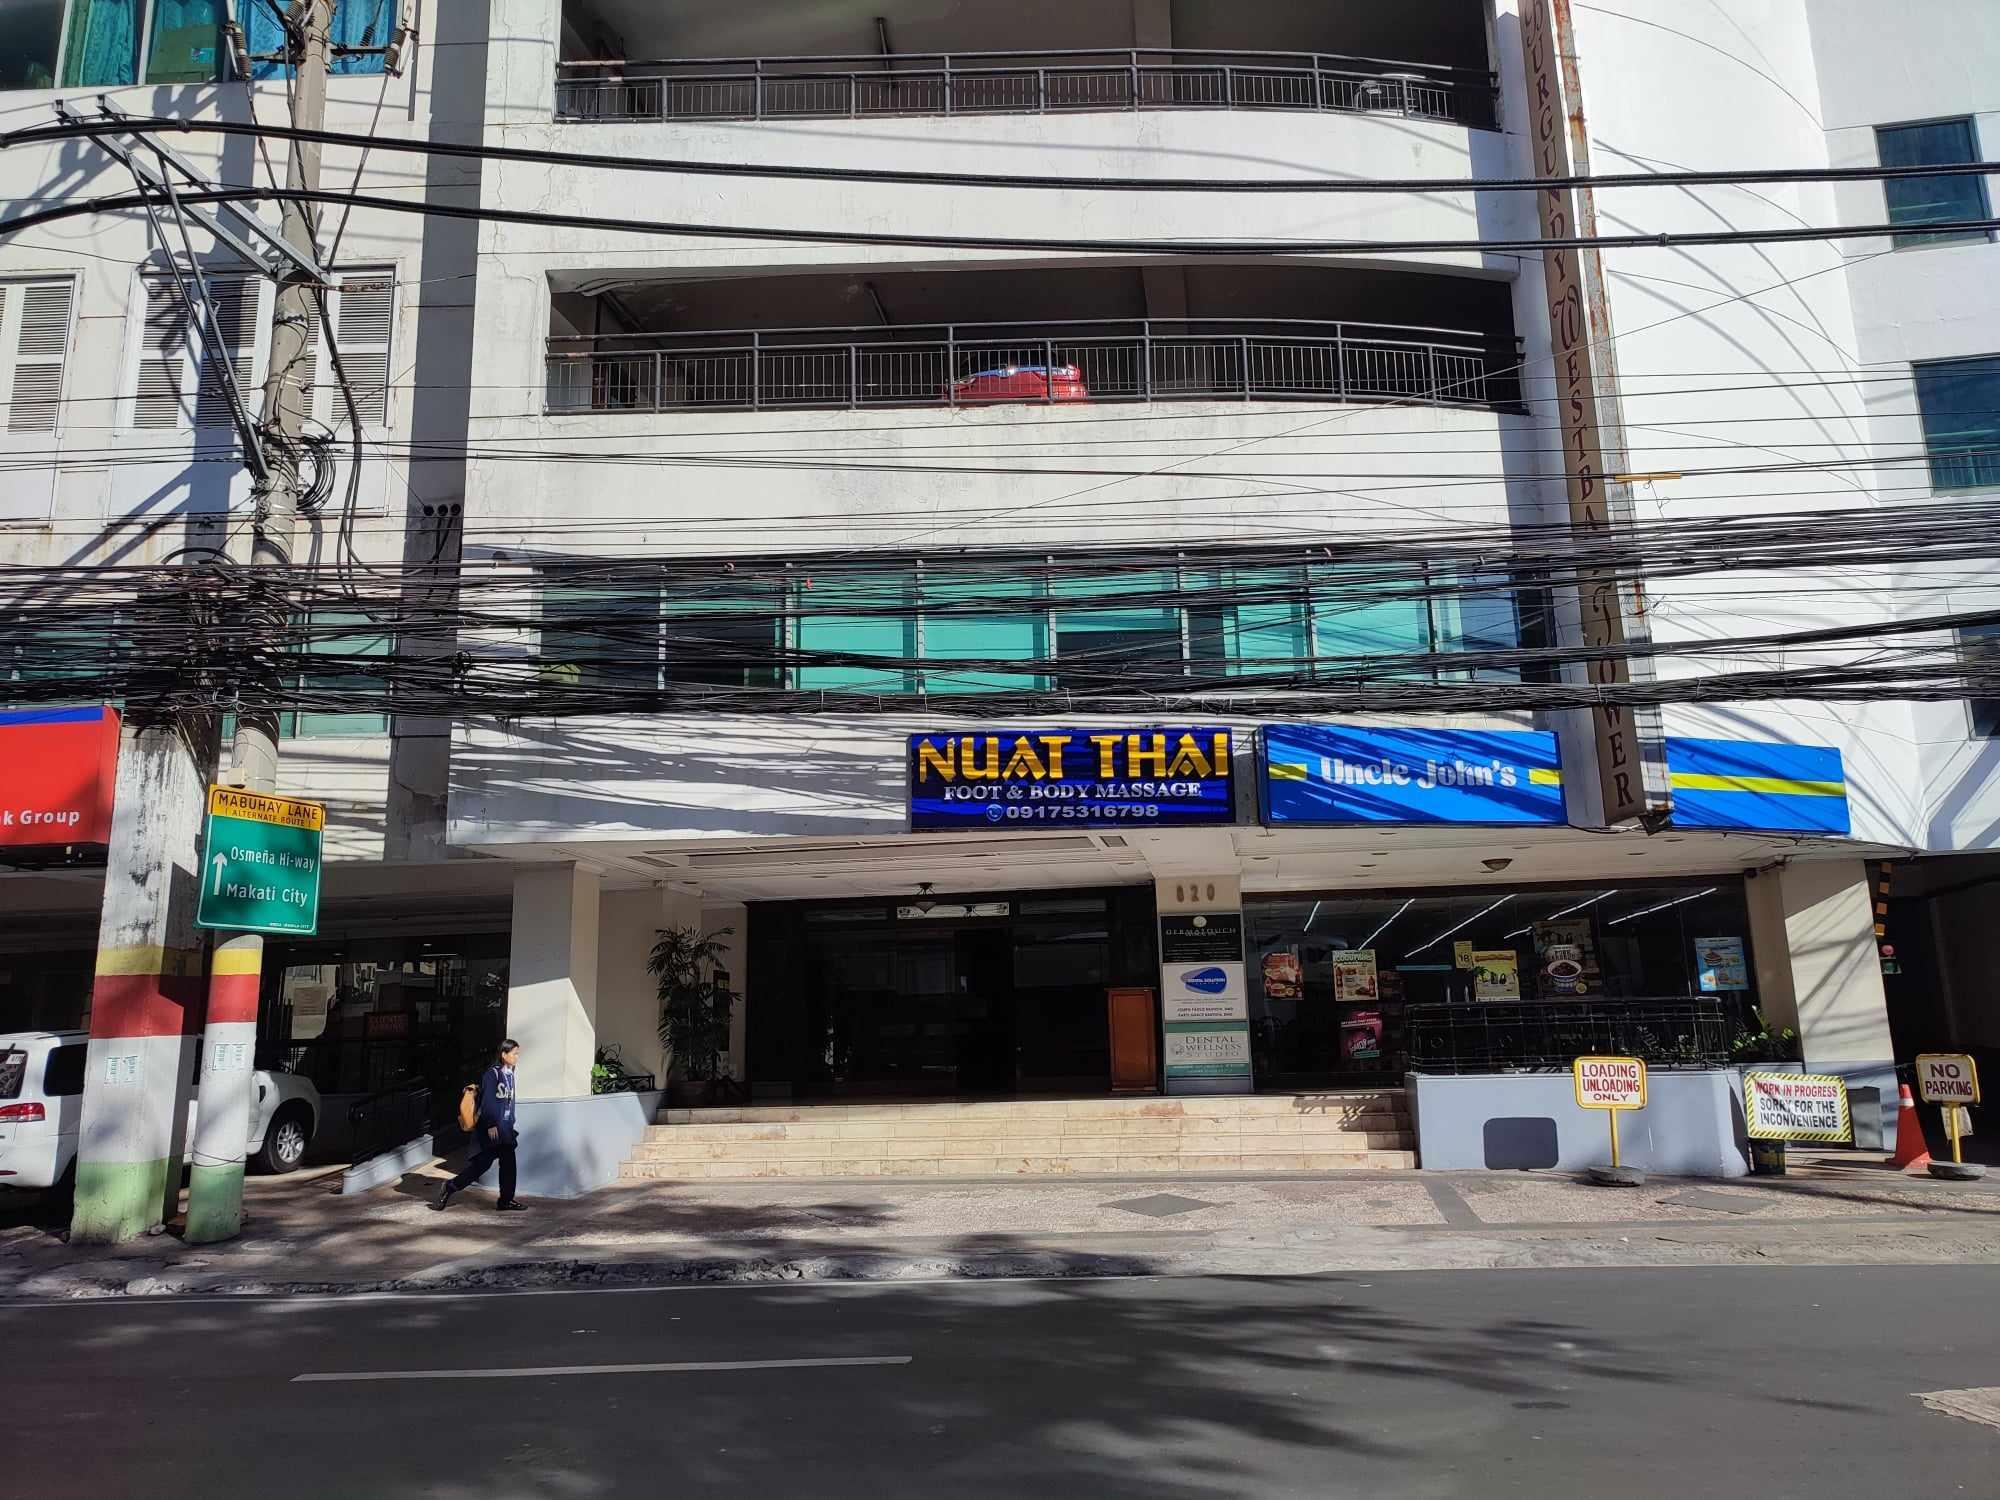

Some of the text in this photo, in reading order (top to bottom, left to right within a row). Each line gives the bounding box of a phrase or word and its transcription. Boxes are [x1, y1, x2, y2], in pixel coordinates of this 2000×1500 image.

[919, 733, 1229, 783] NUAT THAI
[1320, 756, 1517, 789] Uncle John's
[943, 781, 1202, 801] FOOT & BODY MASSAGE
[218, 793, 319, 820] MABUHAY LANE
[1006, 805, 1159, 819] 09175316798
[20, 810, 80, 827] Group
[231, 846, 315, 873] Osmeña Hi-way
[226, 883, 308, 908] Makati City
[1185, 1035, 1236, 1044] DENTAL
[1581, 1064, 1637, 1078] LOADING
[1930, 1063, 1960, 1078] NO
[1583, 1078, 1640, 1093] UNLOADING
[1754, 1081, 1838, 1098] WORK IN PROGRESS
[1925, 1080, 1973, 1096] PARKING
[1593, 1093, 1629, 1101] ONLY
[1794, 1100, 1814, 1114] FOR
[1816, 1100, 1836, 1114] THE
[1760, 1112, 1838, 1129] INCONVENIENCE
